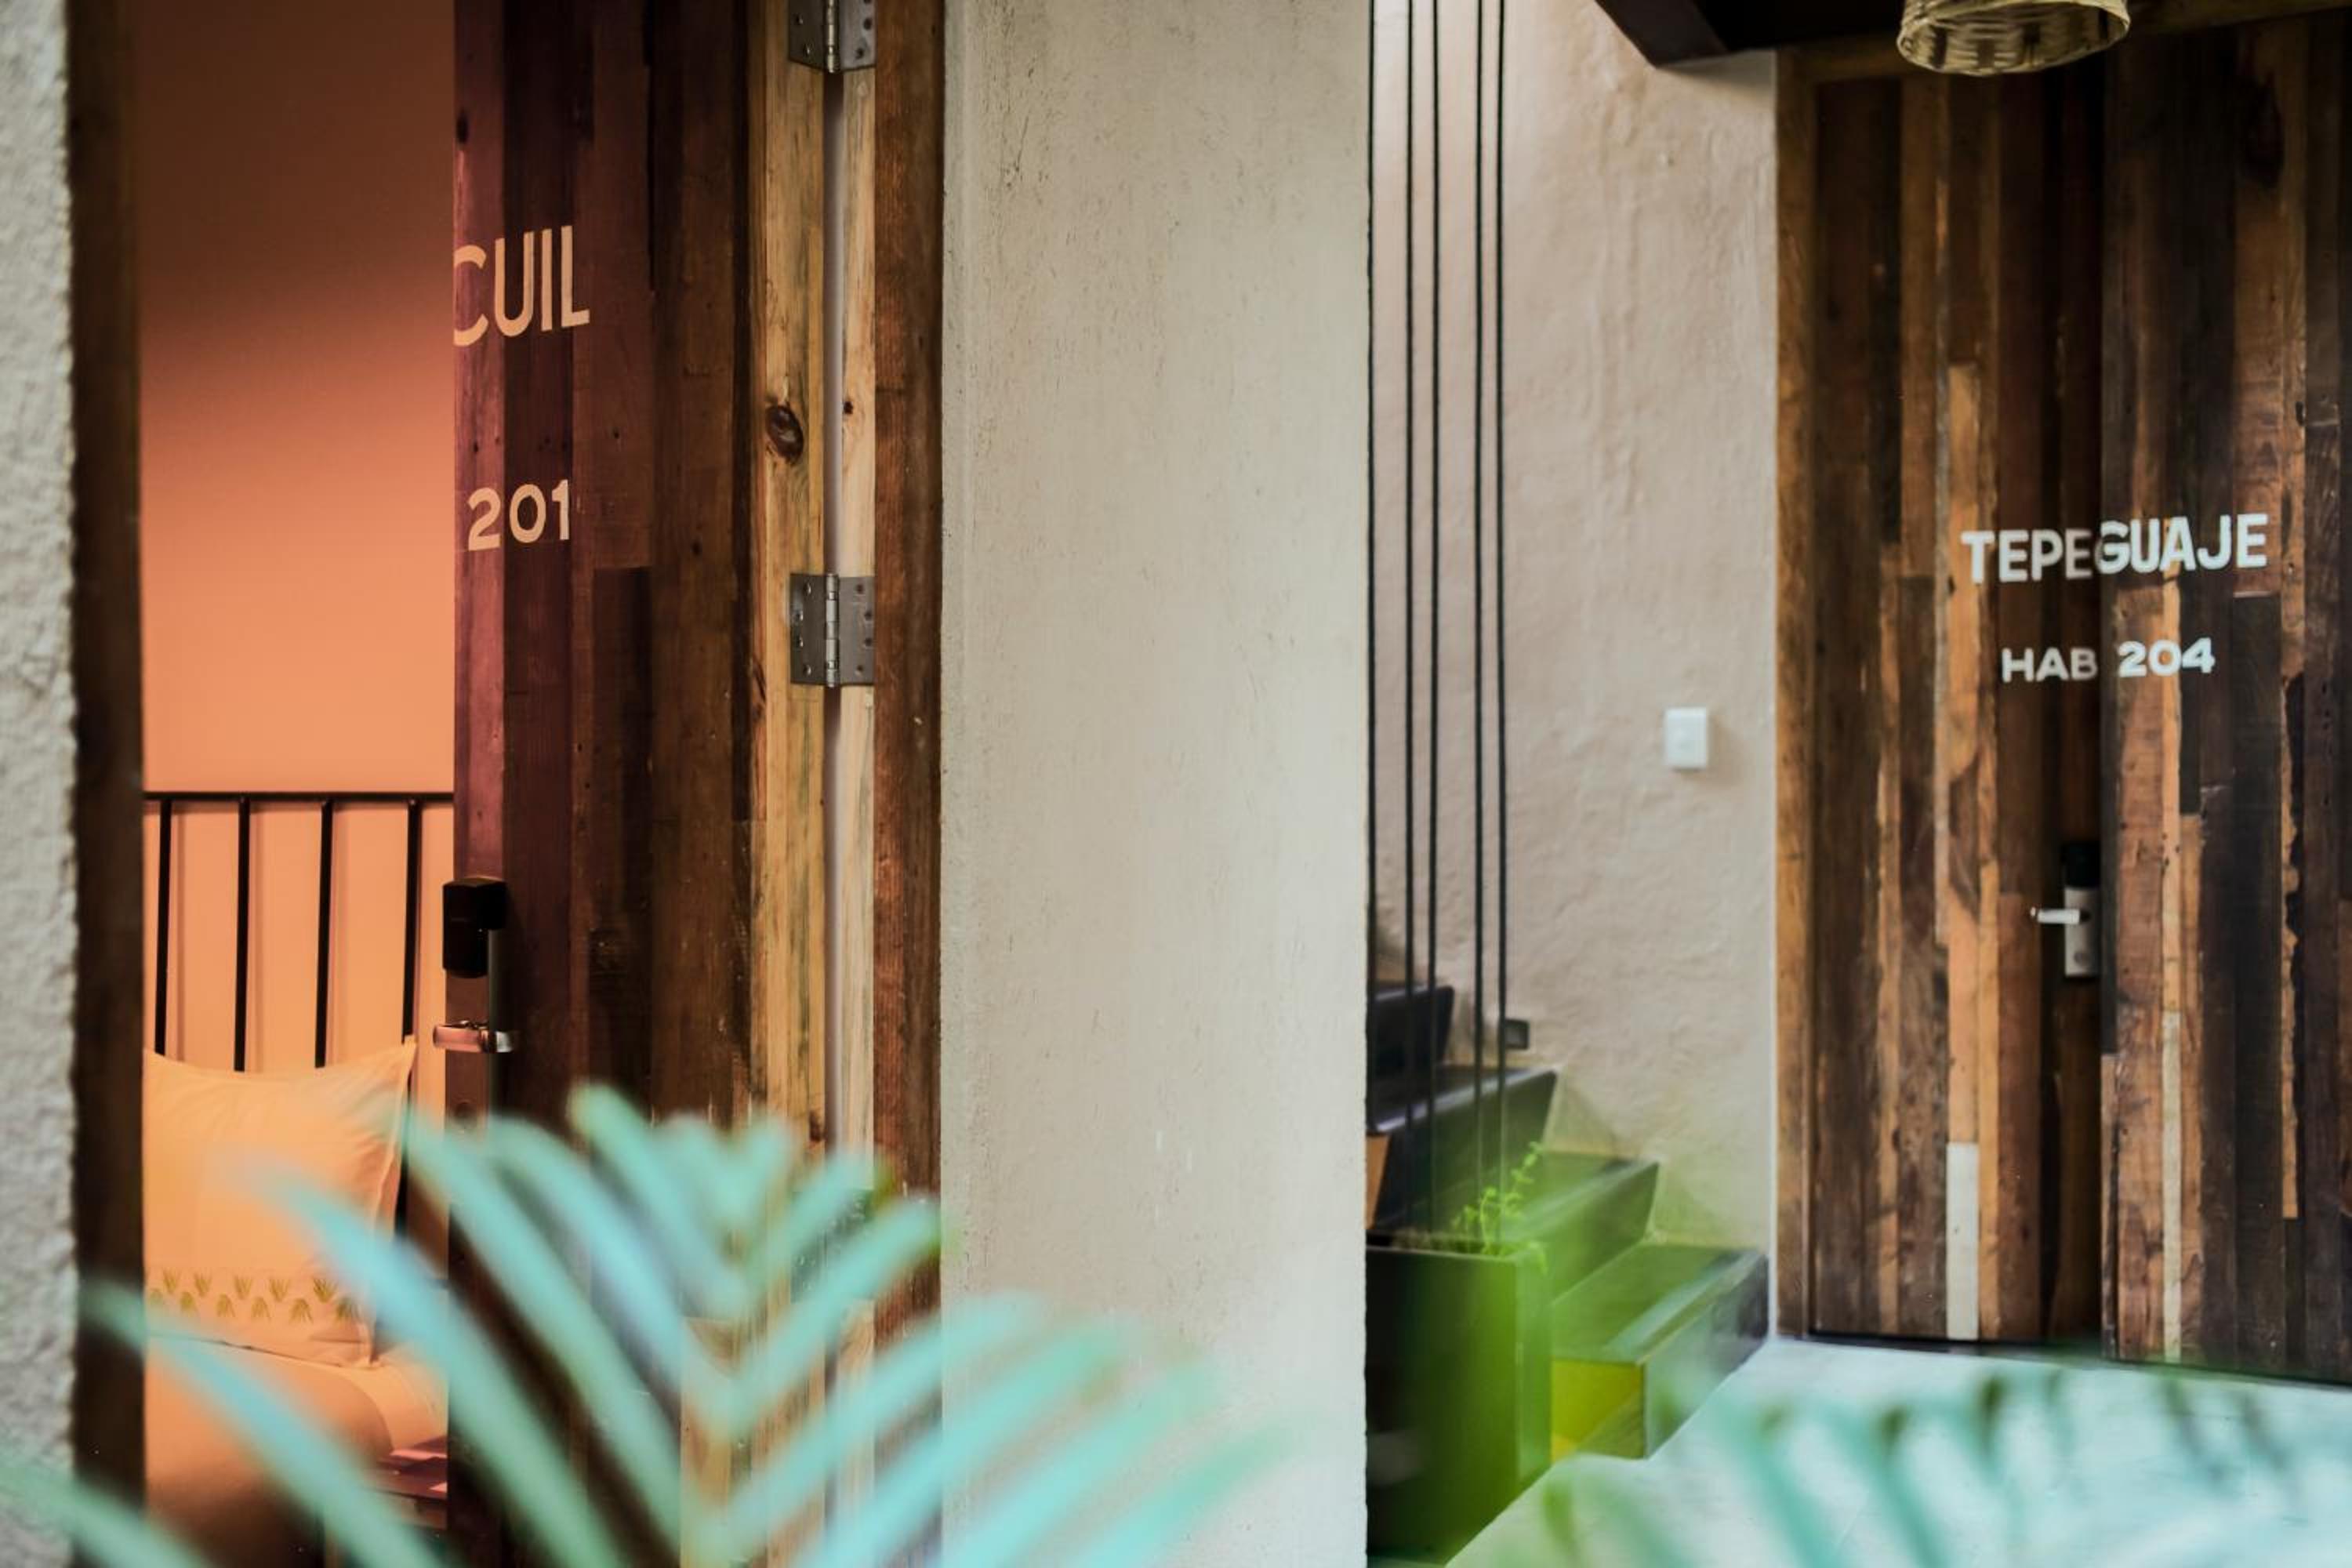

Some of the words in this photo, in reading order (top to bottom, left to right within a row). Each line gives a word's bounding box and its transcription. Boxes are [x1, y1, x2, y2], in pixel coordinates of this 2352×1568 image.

[453, 225, 590, 347] CUIL
[467, 479, 571, 551] 201
[1961, 514, 2269, 584] TEPEGUAJE
[2002, 648, 2098, 683] HAB
[2118, 637, 2216, 677] 204
